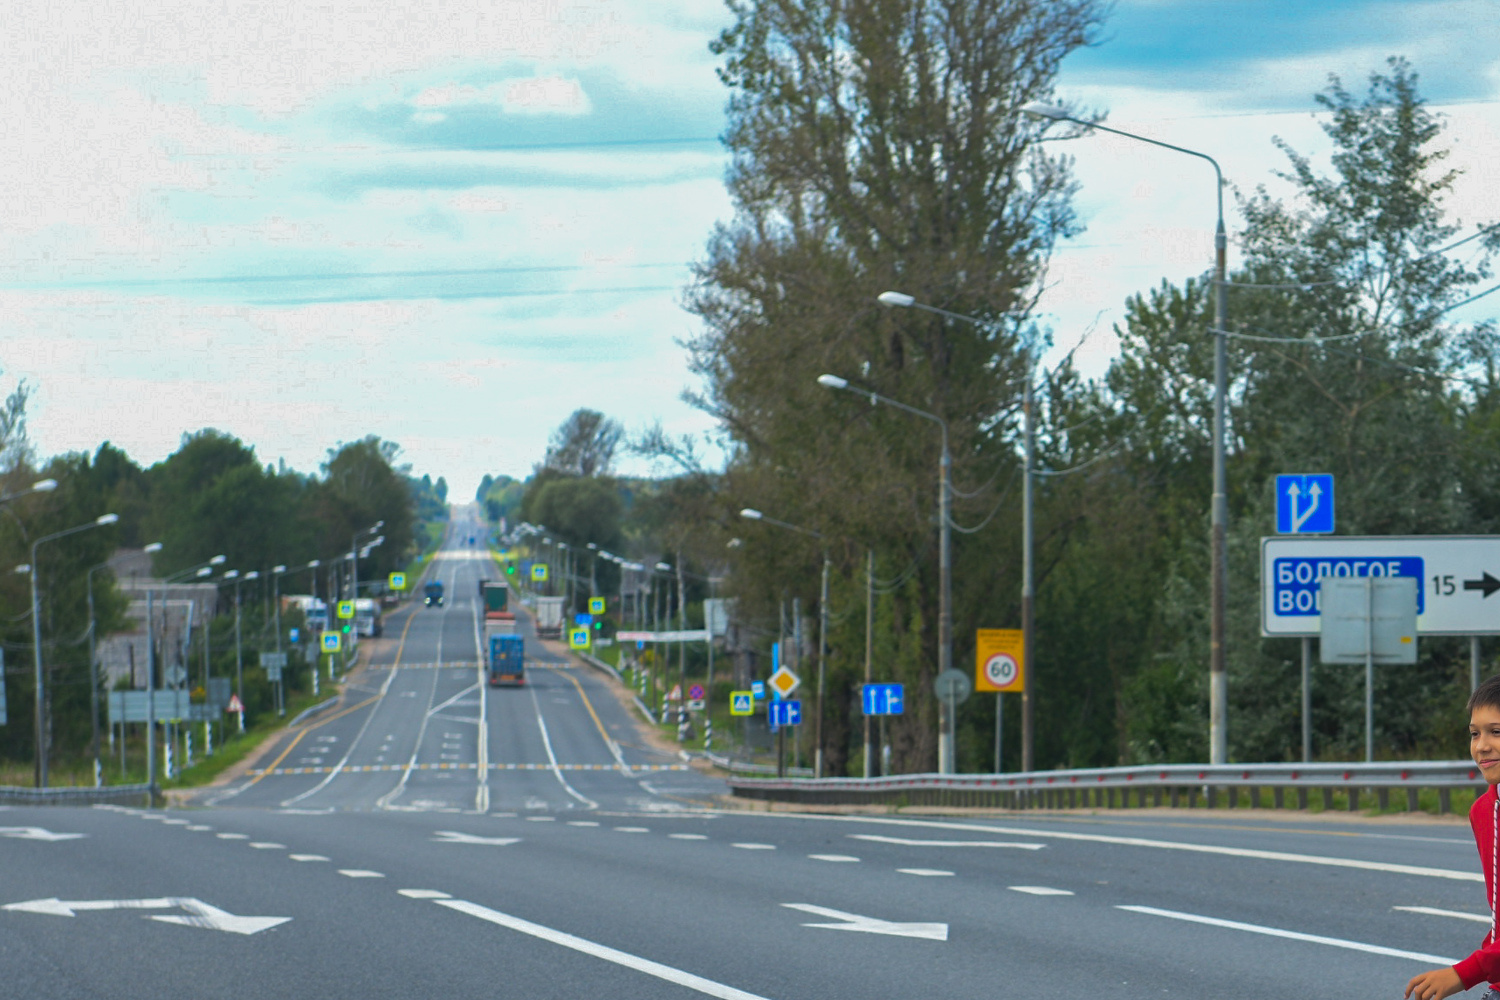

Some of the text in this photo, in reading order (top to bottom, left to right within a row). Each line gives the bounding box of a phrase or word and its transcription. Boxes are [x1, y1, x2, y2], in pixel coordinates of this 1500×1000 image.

[1278, 561, 1401, 584] БОЛОГОЕ
[1432, 575, 1456, 596] 15
[991, 661, 1012, 678] 60
